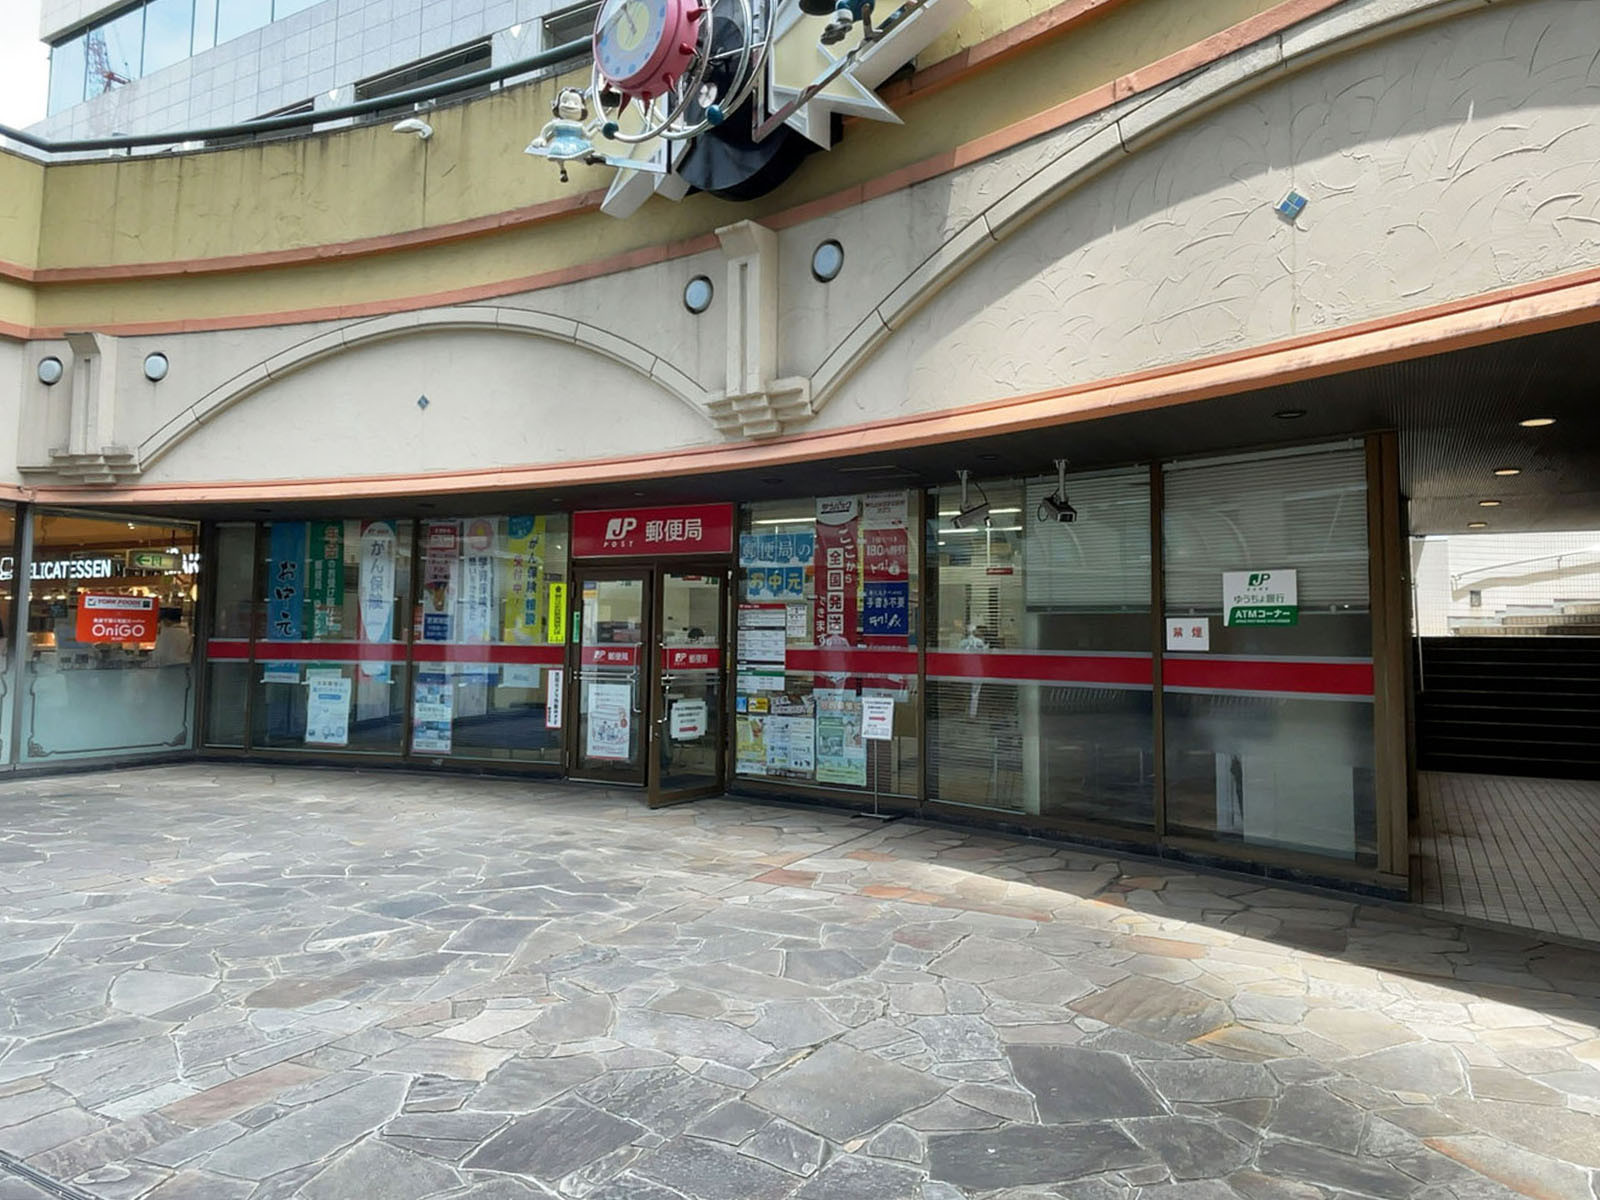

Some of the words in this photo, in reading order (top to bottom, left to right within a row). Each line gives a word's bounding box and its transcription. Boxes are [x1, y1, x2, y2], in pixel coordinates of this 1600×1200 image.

[645, 519, 702, 543] 郵便局
[742, 542, 811, 560] 郵便局の
[838, 529, 856, 584] ここから
[368, 540, 385, 610] がん保険
[750, 572, 802, 590] お中元
[828, 549, 843, 633] 全国発送
[1234, 593, 1285, 604] ゆうちょ銀行
[866, 597, 905, 608] 手書き不要
[1235, 608, 1290, 619] ATMコーナー
[92, 624, 145, 637] OniGO
[1173, 626, 1203, 638] 禁煙
